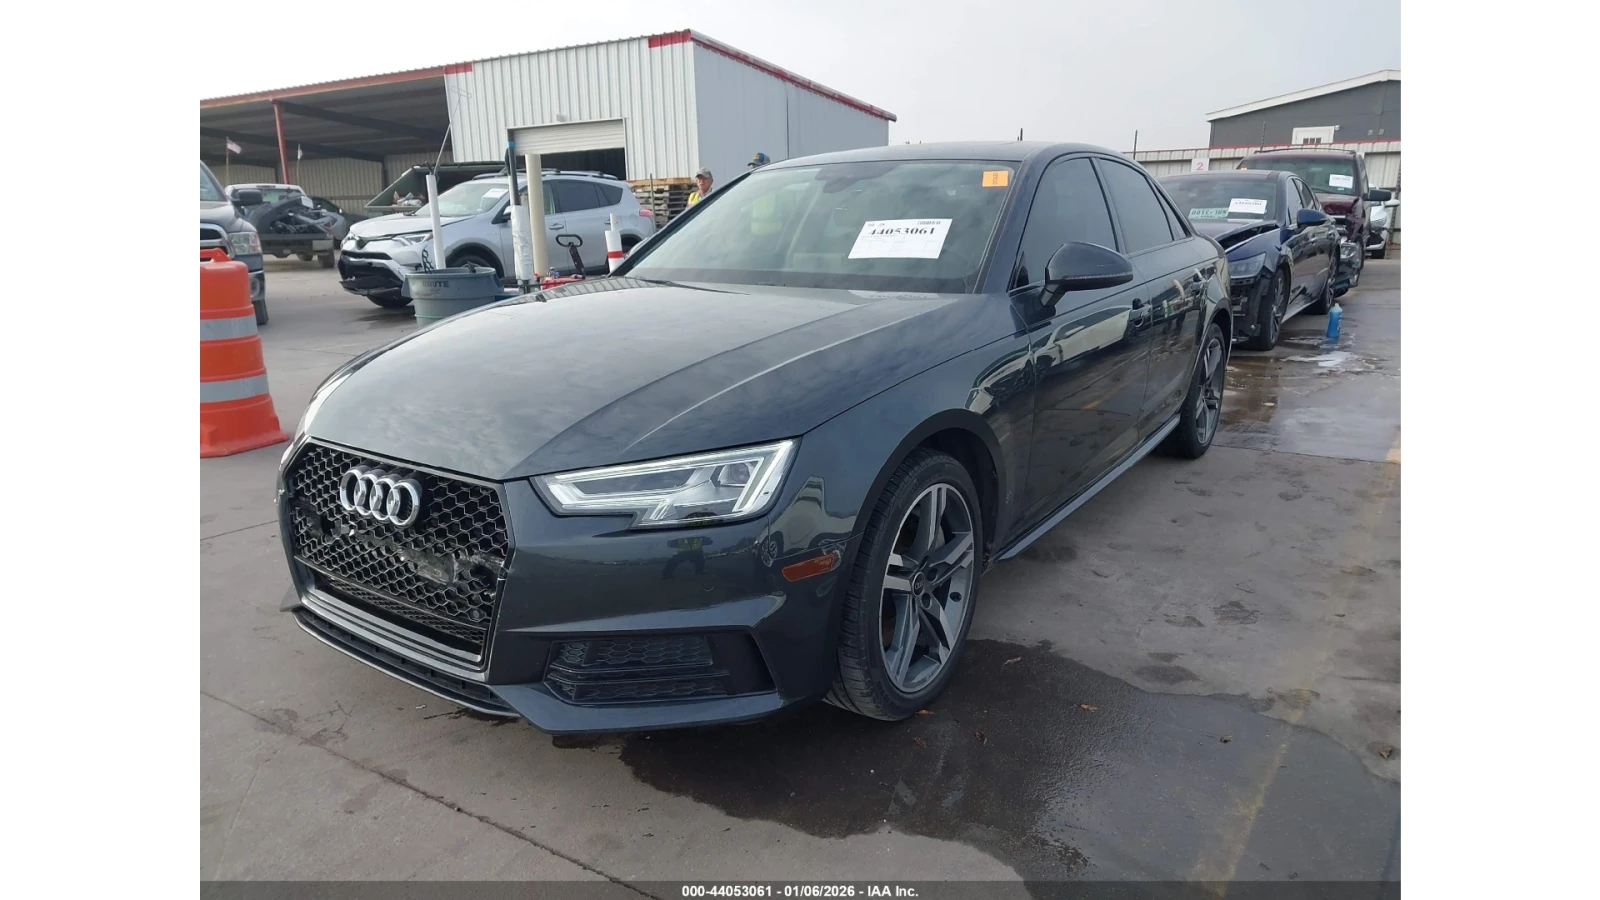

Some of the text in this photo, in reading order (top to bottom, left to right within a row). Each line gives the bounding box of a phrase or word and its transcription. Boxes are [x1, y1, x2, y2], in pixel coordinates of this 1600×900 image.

[1195, 162, 1204, 171] 2
[869, 227, 935, 236] 44053061
[422, 280, 450, 288] BRUTE
